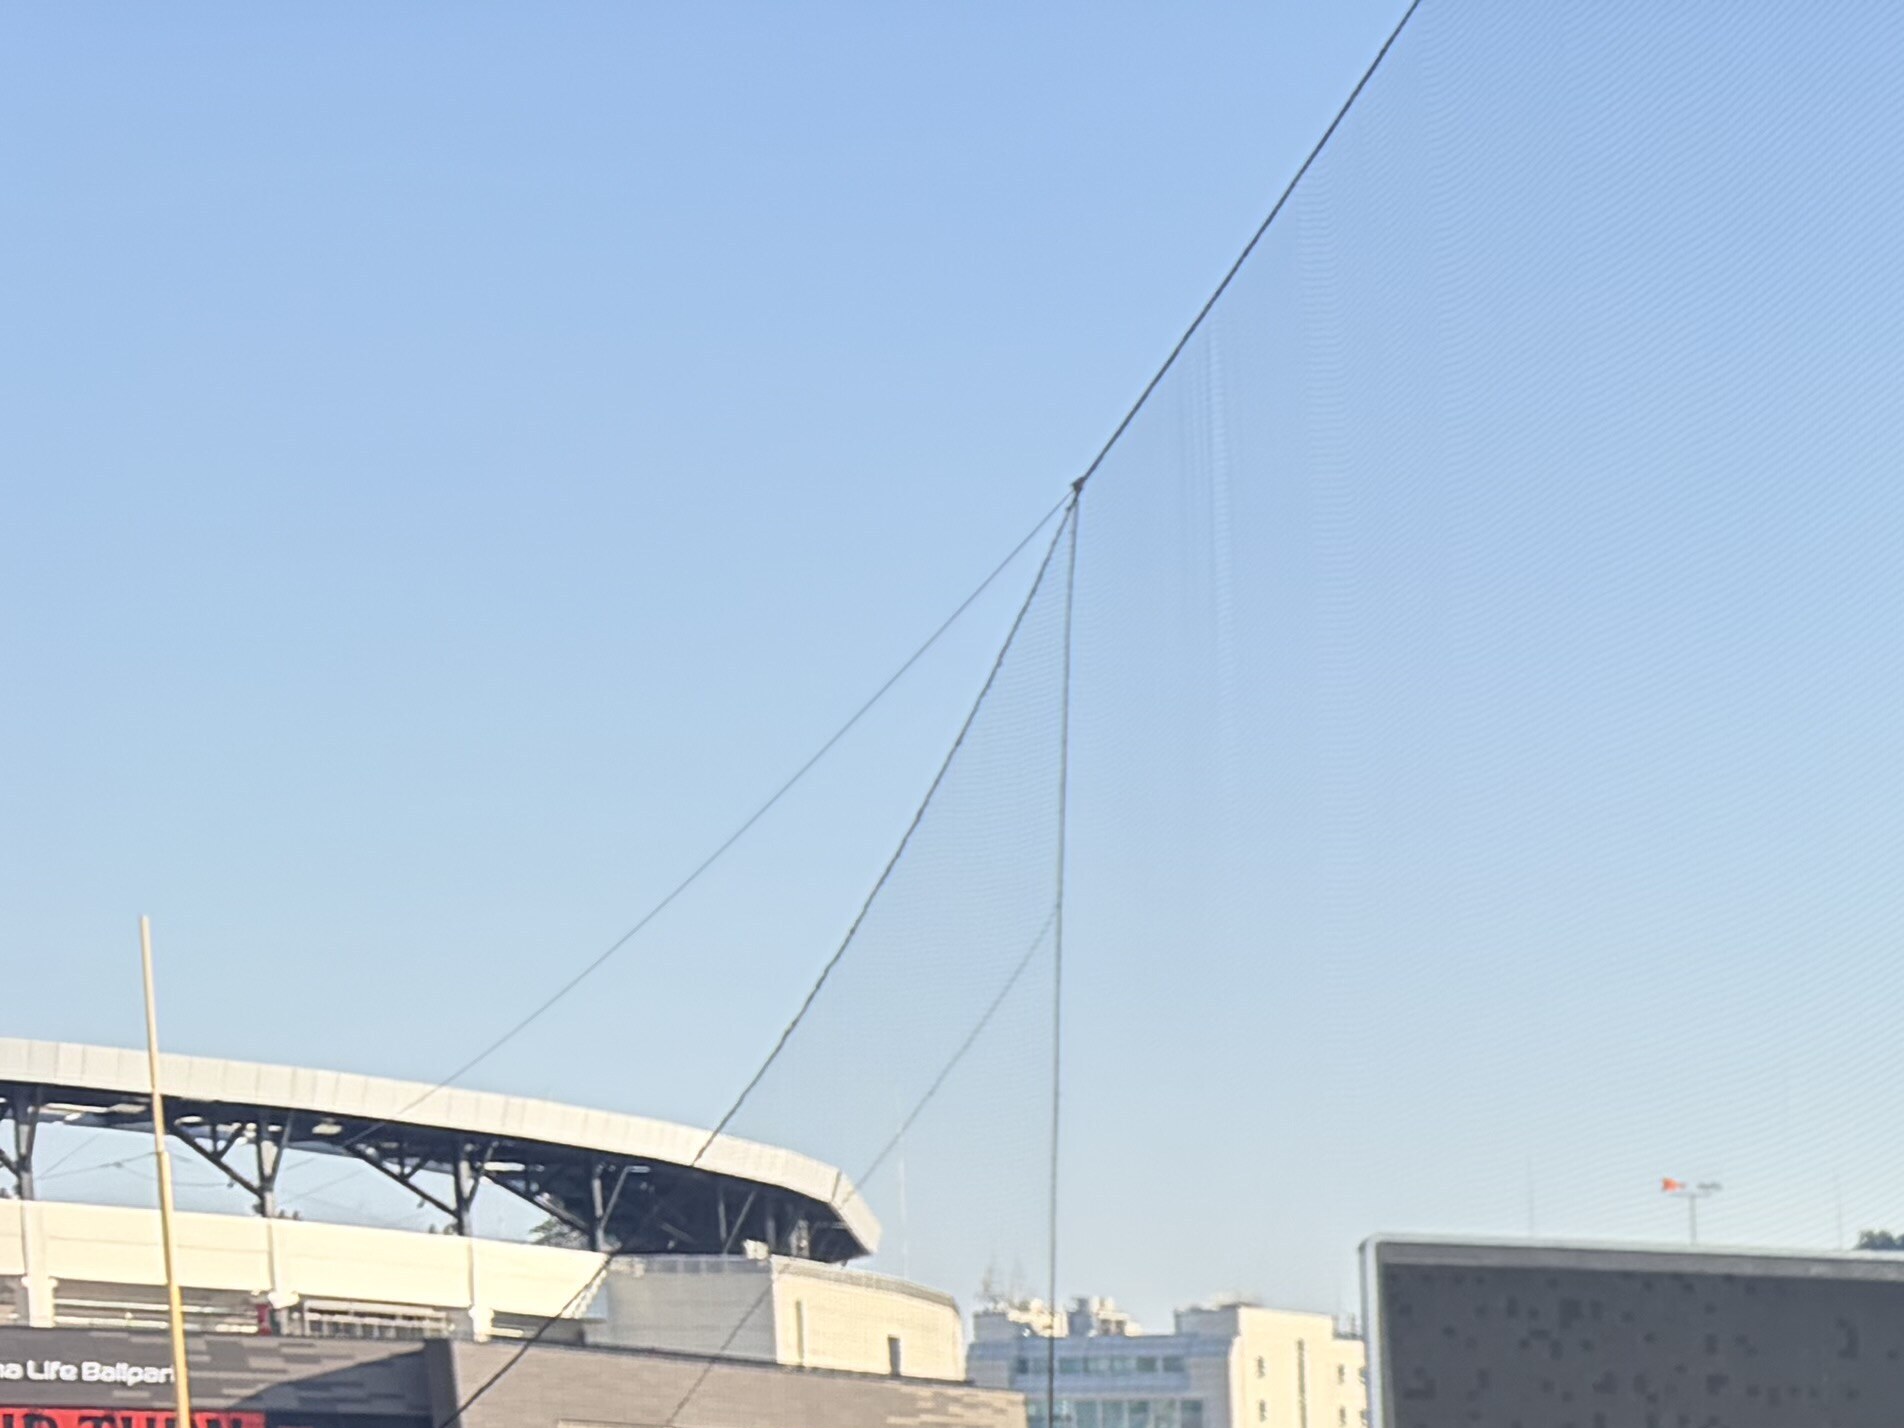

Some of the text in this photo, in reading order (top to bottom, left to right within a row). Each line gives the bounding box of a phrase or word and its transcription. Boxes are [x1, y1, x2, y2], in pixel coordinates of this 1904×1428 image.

[0, 1360, 175, 1387] a Life Ballpar
